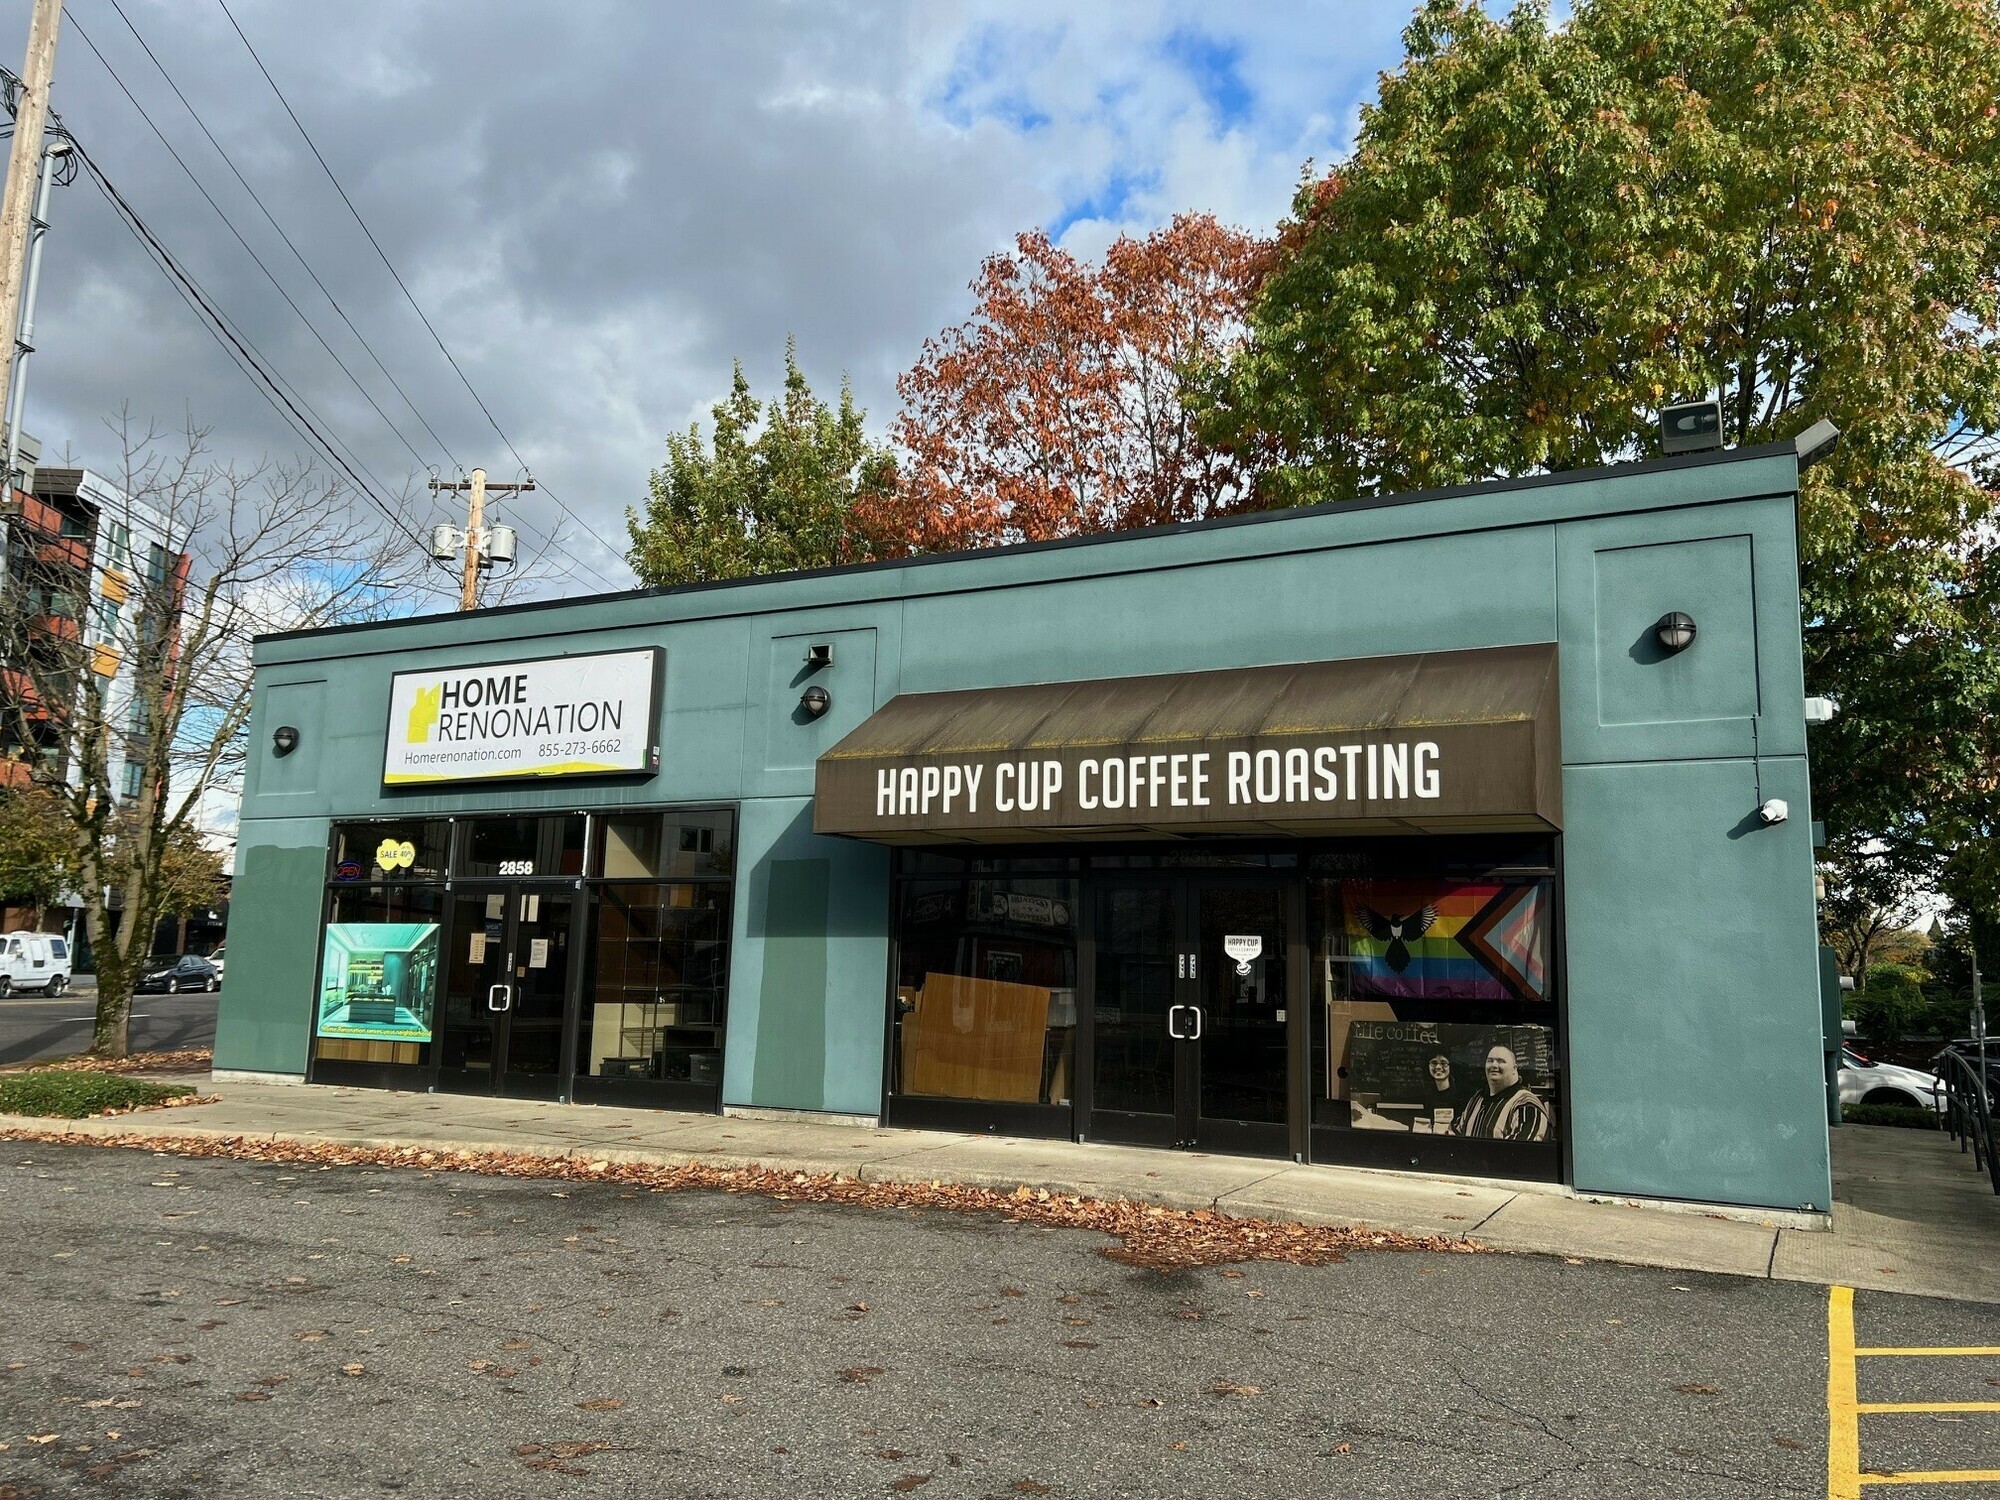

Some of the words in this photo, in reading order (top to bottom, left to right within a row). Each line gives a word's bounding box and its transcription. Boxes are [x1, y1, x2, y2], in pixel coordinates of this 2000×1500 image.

[441, 675, 528, 709] HOME
[438, 700, 623, 742] RENONATION
[404, 748, 522, 765] Homerenonation.com
[538, 739, 621, 757] 855-273-6662
[876, 764, 984, 816] HAPPY
[995, 760, 1063, 812] CUP
[1078, 753, 1211, 810] COFFEE
[1228, 742, 1441, 805] ROASTING
[380, 851, 398, 859] SALE
[499, 861, 534, 875] 2858
[1227, 938, 1246, 946] HAPPY
[1247, 939, 1259, 947] CUP
